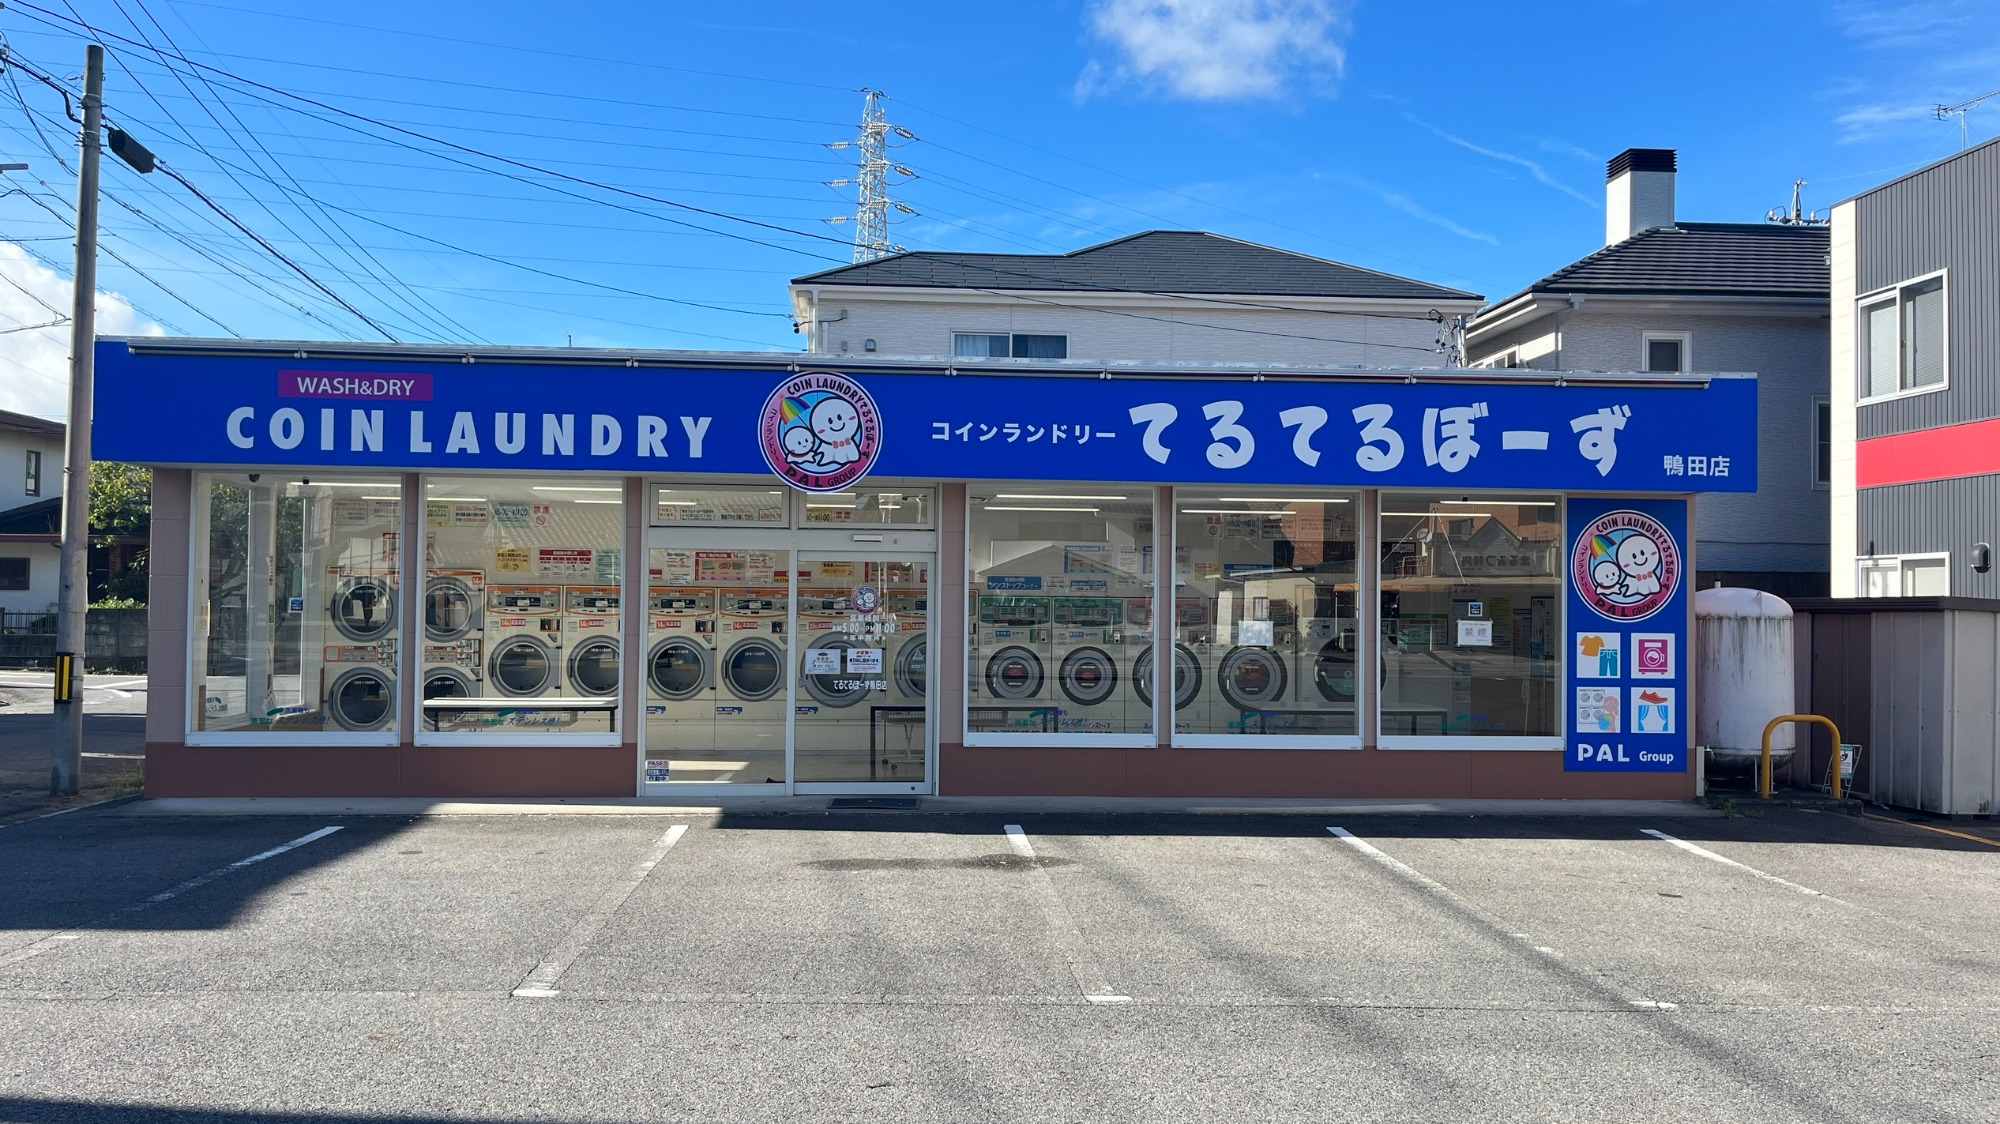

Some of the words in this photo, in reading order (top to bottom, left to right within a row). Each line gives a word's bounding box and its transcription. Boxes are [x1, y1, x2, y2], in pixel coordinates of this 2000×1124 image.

[298, 378, 415, 396] WASH&DRY
[787, 378, 813, 396] COIN
[816, 378, 864, 404] LAUNDRY
[228, 407, 384, 452] COIN
[410, 411, 712, 458] LAUNDRY
[932, 422, 1116, 445] コインランドリー
[1128, 401, 1632, 477] てるてるぼーず
[784, 466, 823, 488] PAL
[827, 467, 857, 487] GROUP
[1664, 455, 1730, 477] 鴨田店
[1596, 516, 1619, 533] COIN
[1622, 516, 1664, 541] LAUNDRY
[1594, 597, 1629, 617] PAL
[1632, 599, 1658, 617] GROUP
[1577, 744, 1630, 762] PAL
[1639, 751, 1674, 764] Group
